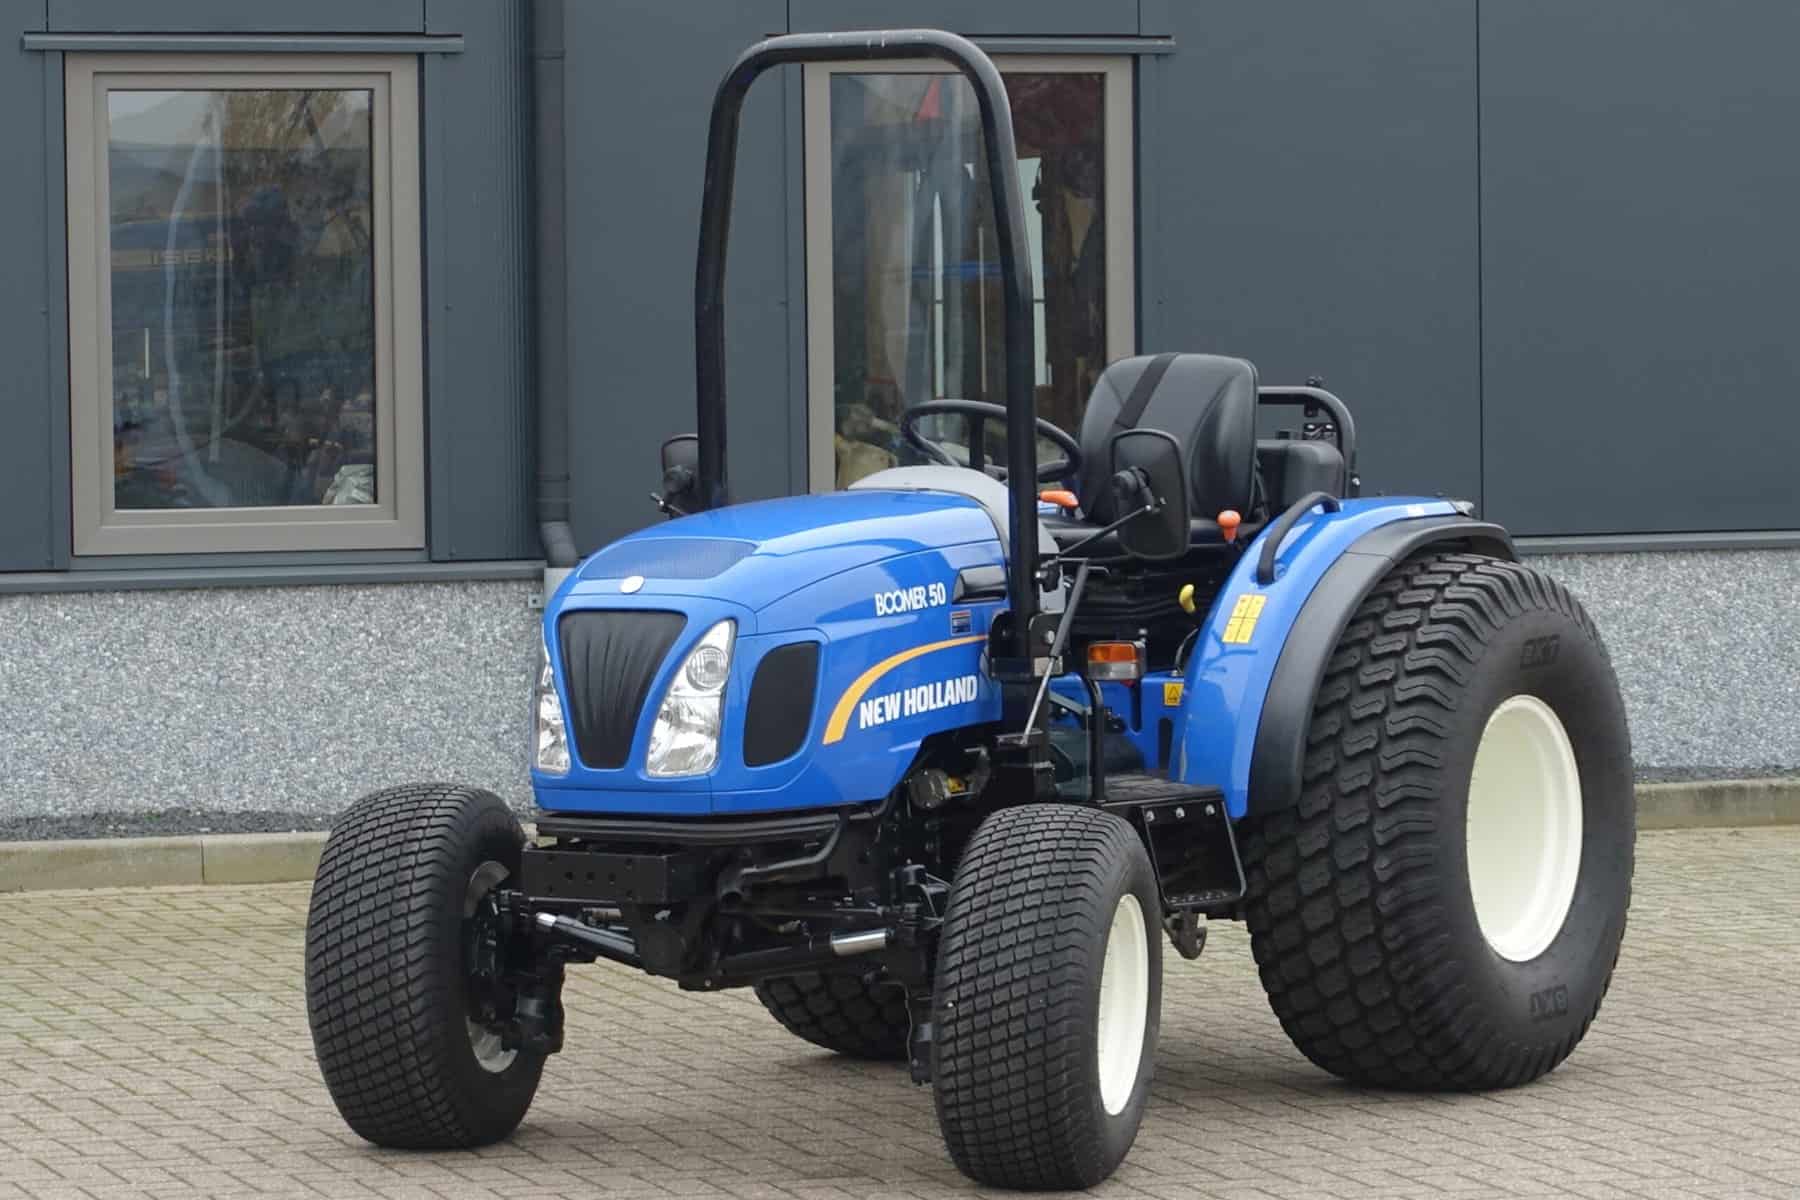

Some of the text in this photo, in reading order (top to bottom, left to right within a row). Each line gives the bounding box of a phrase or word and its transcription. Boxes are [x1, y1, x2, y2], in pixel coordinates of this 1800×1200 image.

[875, 582, 946, 616] BOOMER 50
[860, 675, 977, 729] NEW HOLLAND
